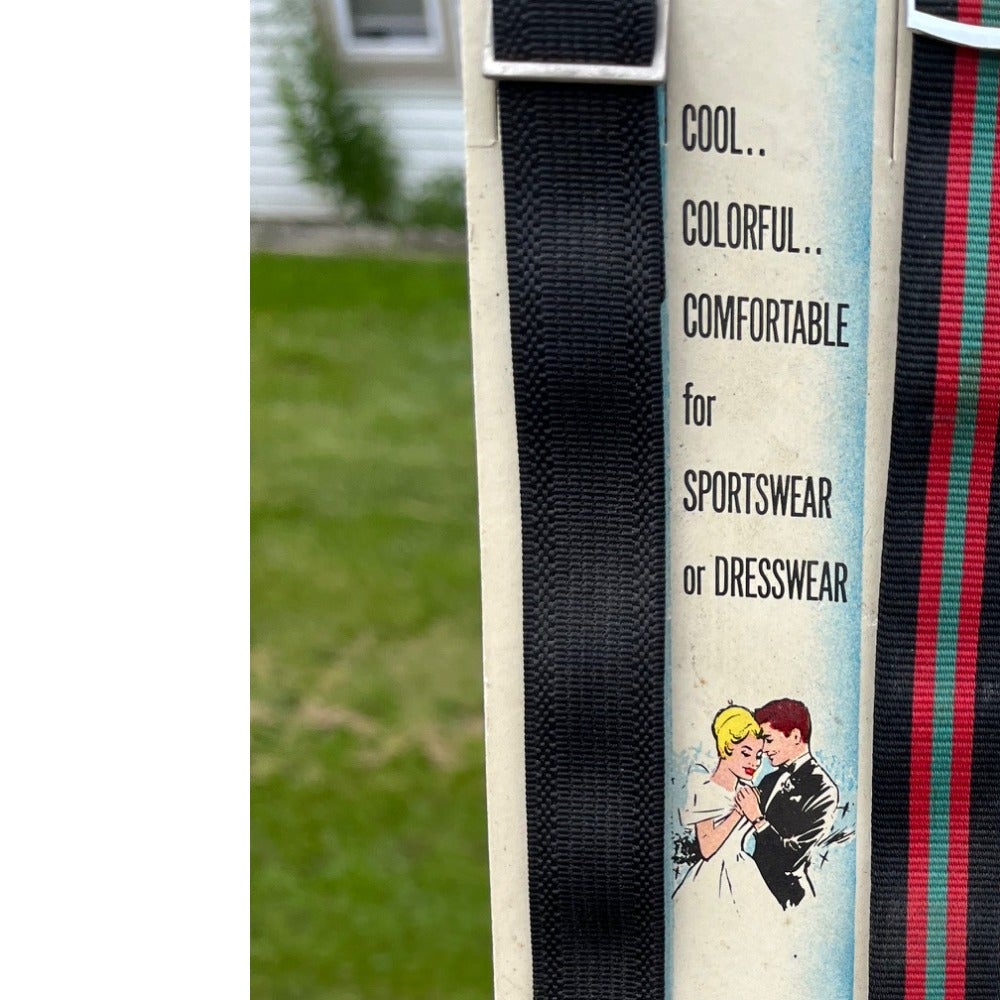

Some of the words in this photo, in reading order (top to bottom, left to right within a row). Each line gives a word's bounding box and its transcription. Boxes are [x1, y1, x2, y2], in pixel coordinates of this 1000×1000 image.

[681, 103, 766, 157] COOL..
[681, 198, 822, 256] COLORFUL..
[682, 292, 850, 348] COMFORTABLE
[682, 381, 717, 427] for
[682, 468, 833, 519] SPORTSWEAR
[683, 564, 706, 596] or
[714, 555, 849, 604] DRESSWEAR
